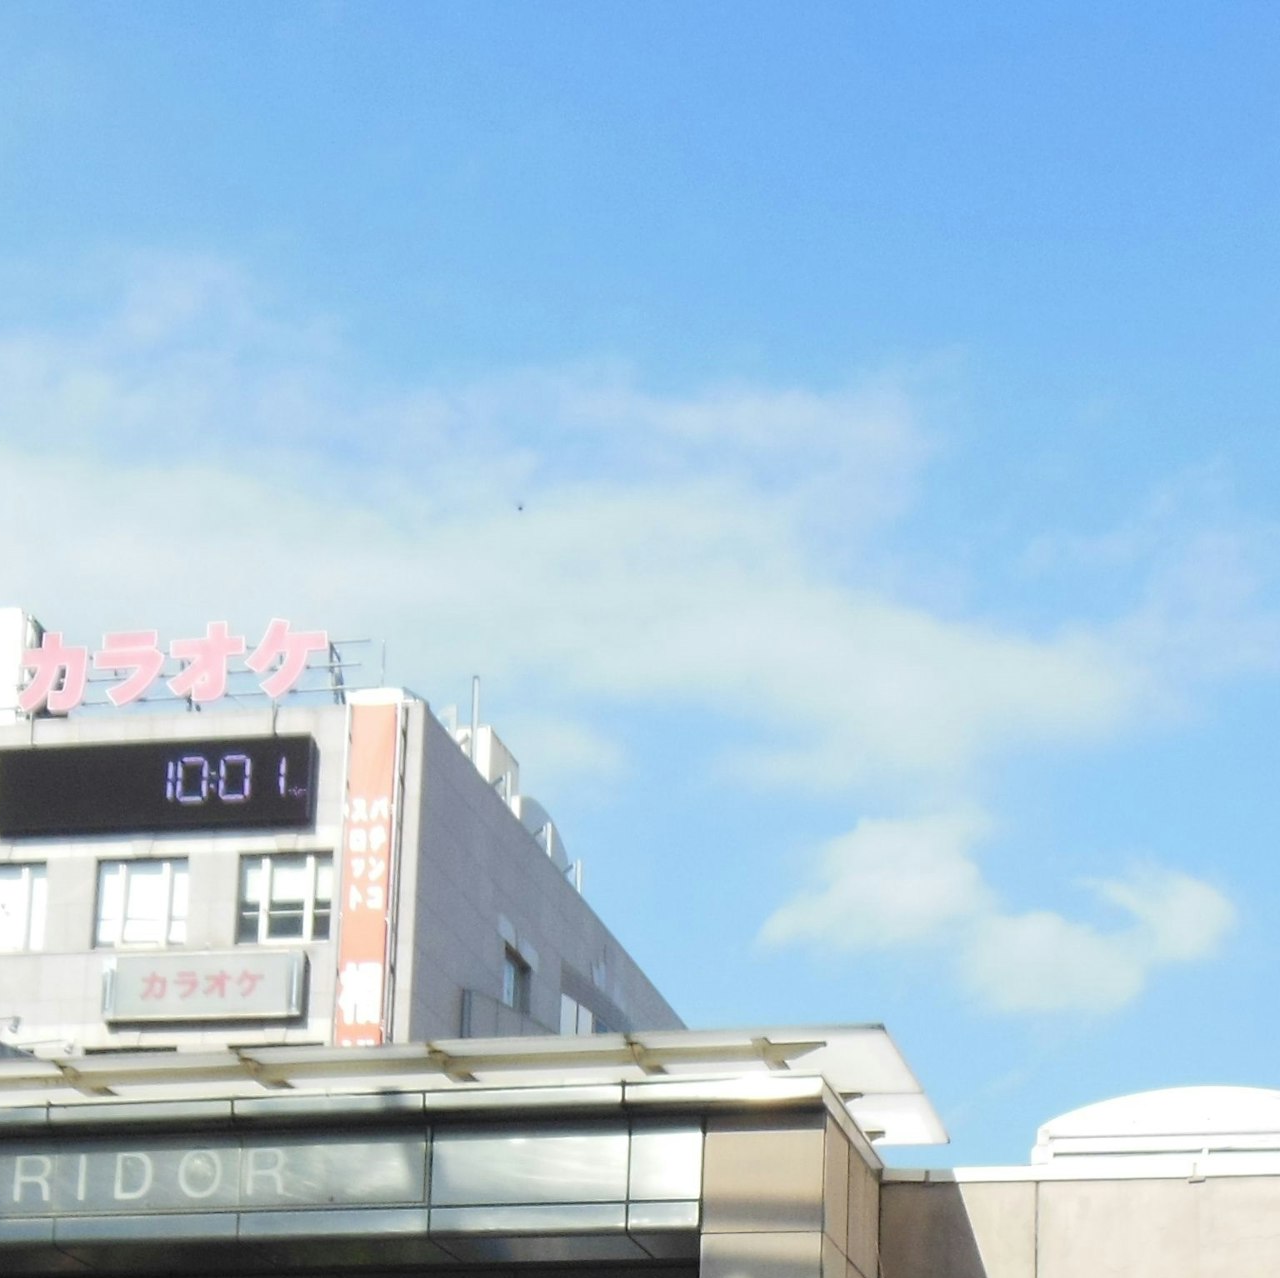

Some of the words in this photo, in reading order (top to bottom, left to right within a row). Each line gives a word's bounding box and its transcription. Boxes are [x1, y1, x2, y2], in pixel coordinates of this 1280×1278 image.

[19, 618, 327, 713] カラオケ
[166, 754, 286, 805] 10:01
[367, 797, 390, 911] パチンコ
[140, 971, 263, 1001] カラオケ
